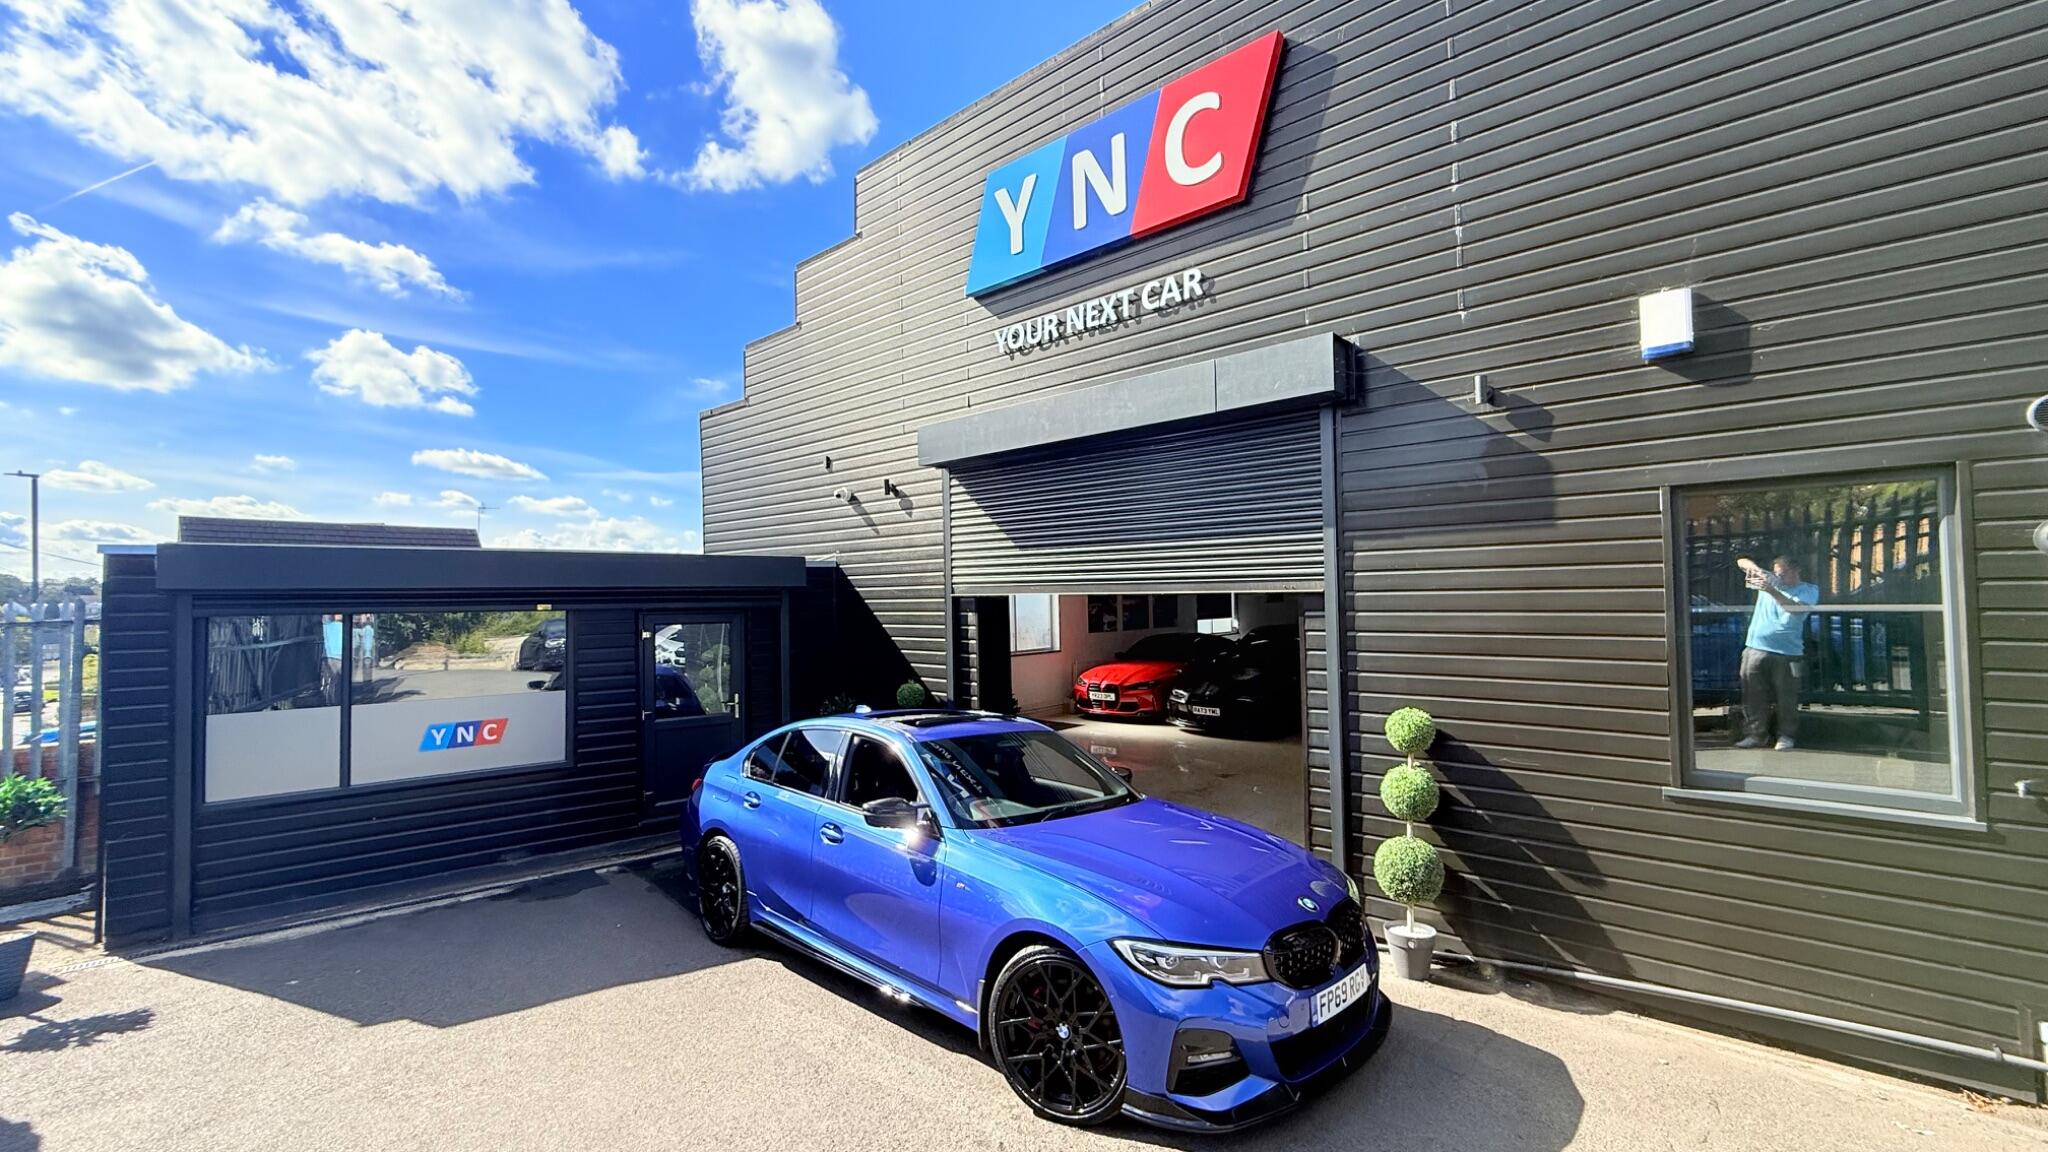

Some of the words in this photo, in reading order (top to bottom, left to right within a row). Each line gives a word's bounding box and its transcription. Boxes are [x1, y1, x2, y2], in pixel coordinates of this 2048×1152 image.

[994, 91, 1224, 255] YNC
[994, 313, 1060, 354] YOUR
[1066, 288, 1135, 334] NEXT
[1141, 267, 1204, 311] CAR
[431, 723, 498, 746] YNC
[1319, 981, 1348, 1018] FP69
